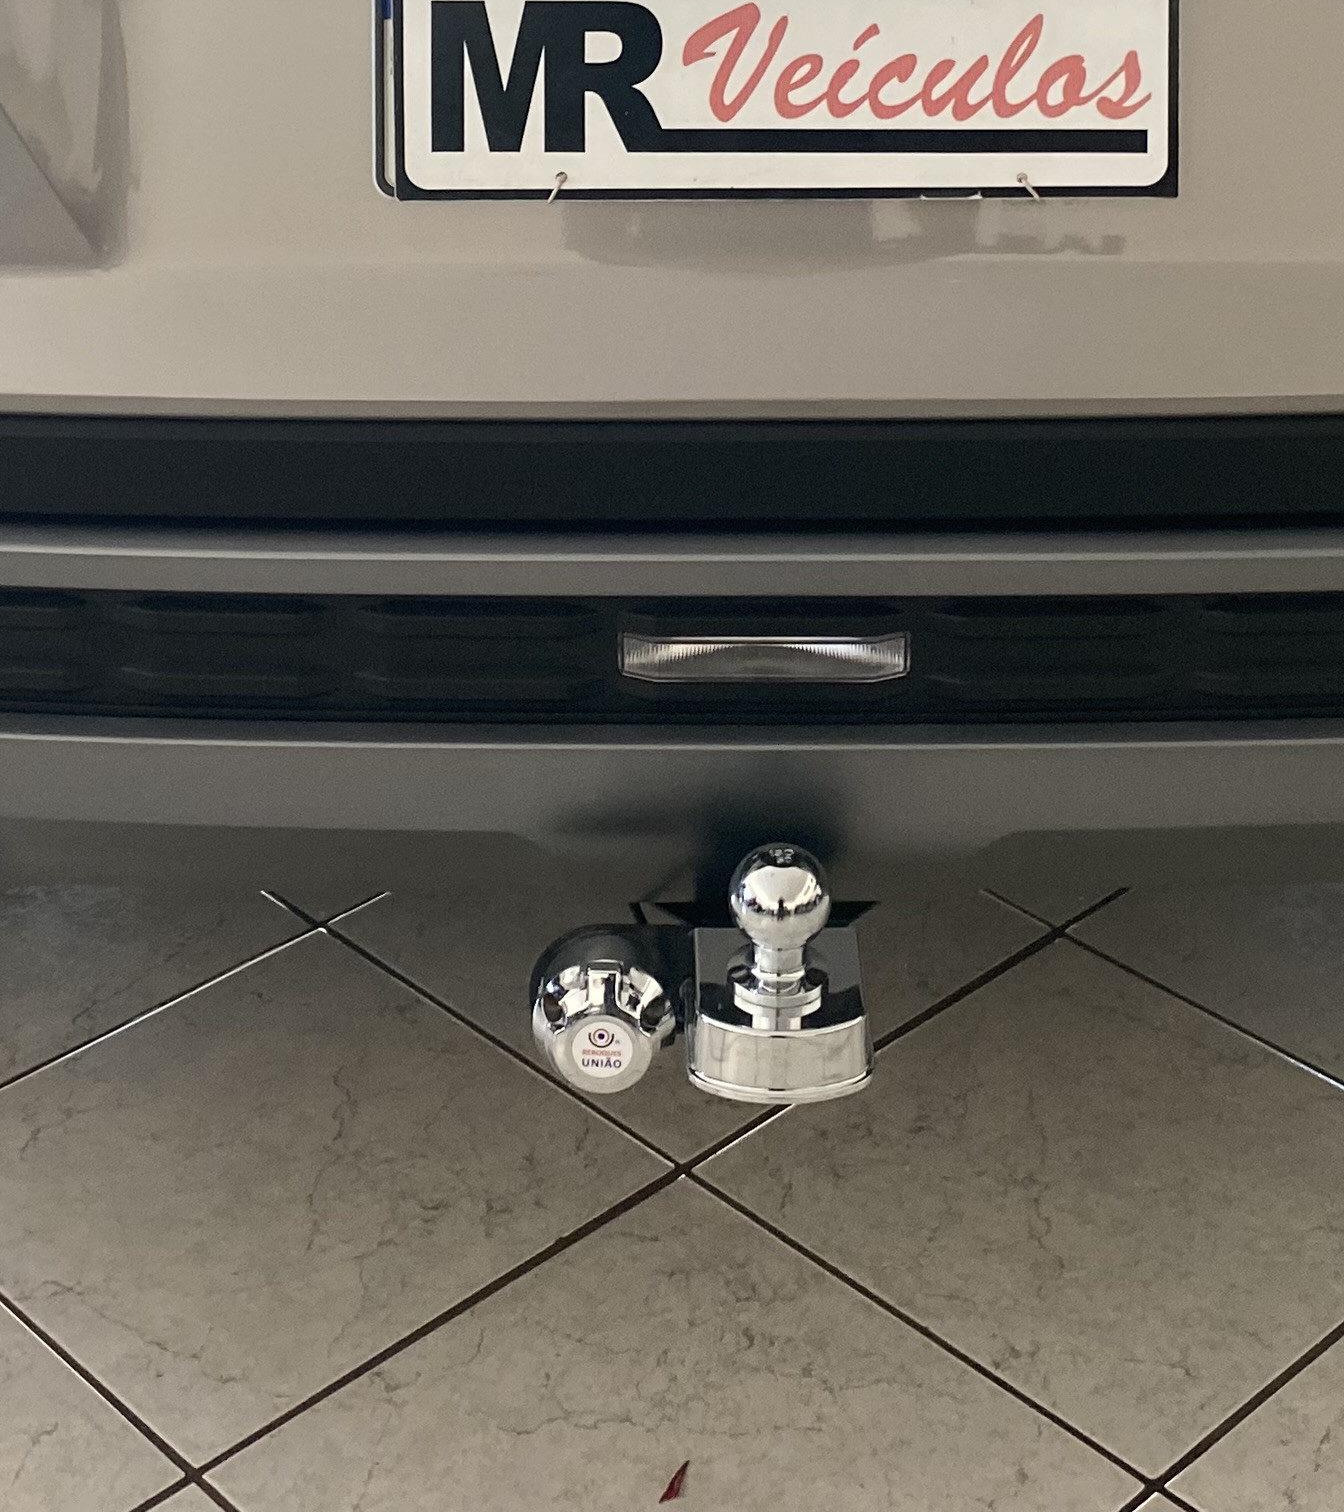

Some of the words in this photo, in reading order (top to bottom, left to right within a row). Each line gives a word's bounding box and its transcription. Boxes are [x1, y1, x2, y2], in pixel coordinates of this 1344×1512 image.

[430, 0, 664, 154] MR
[681, 1, 1153, 124] Veículos
[581, 1057, 622, 1069] UNIÃO
